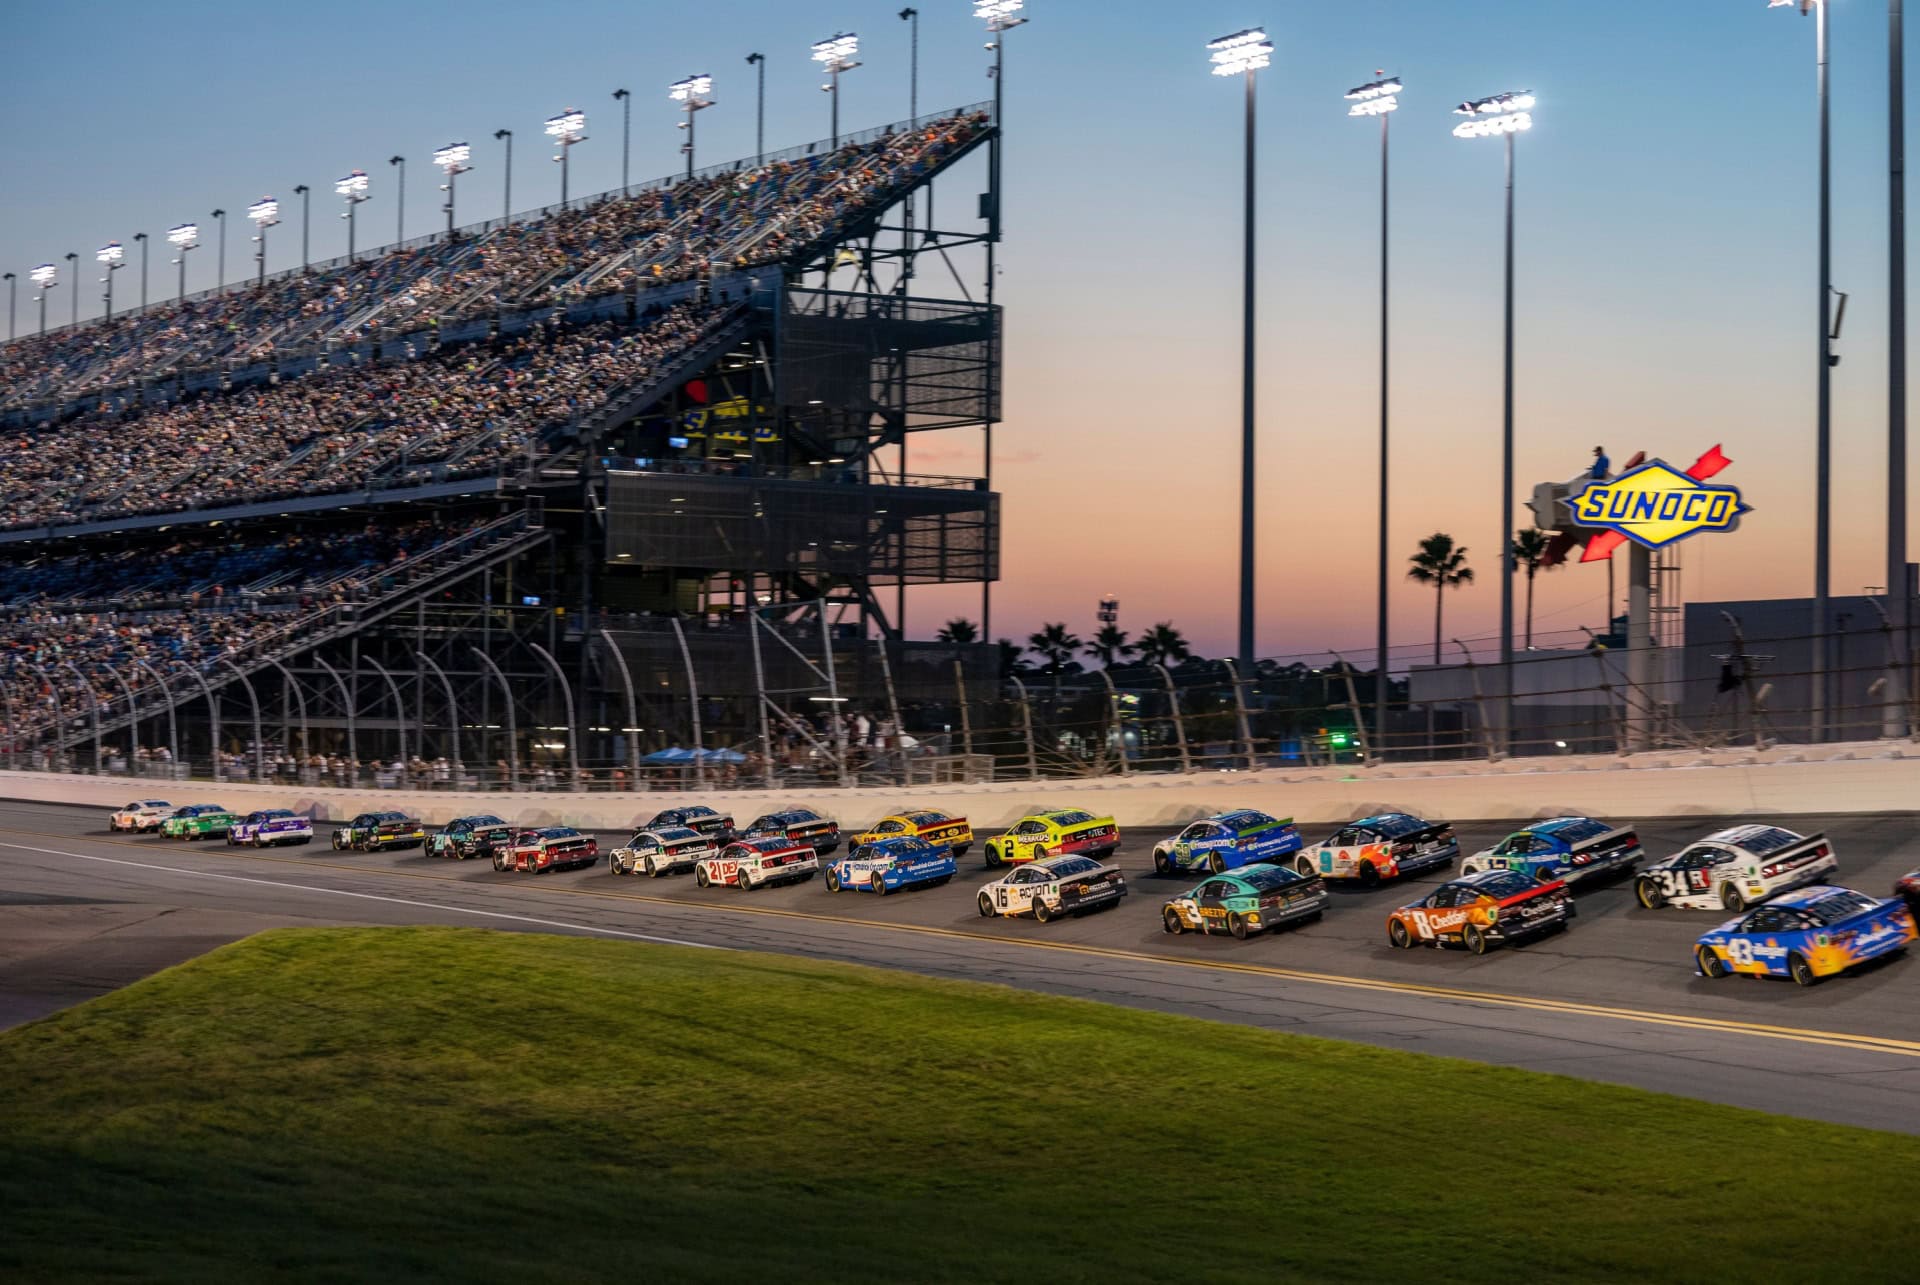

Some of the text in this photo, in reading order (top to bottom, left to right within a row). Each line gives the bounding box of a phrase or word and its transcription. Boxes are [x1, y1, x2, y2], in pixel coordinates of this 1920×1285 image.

[1584, 489, 1731, 522] SUNOCO
[1004, 839, 1014, 857] 2
[709, 860, 722, 881] 21
[842, 863, 852, 883] 5
[1319, 850, 1333, 873] 9
[1661, 870, 1690, 897] 34
[995, 887, 1008, 908] 16
[1182, 899, 1203, 924] 3
[1412, 910, 1436, 939] 8
[1728, 937, 1755, 965] 43
